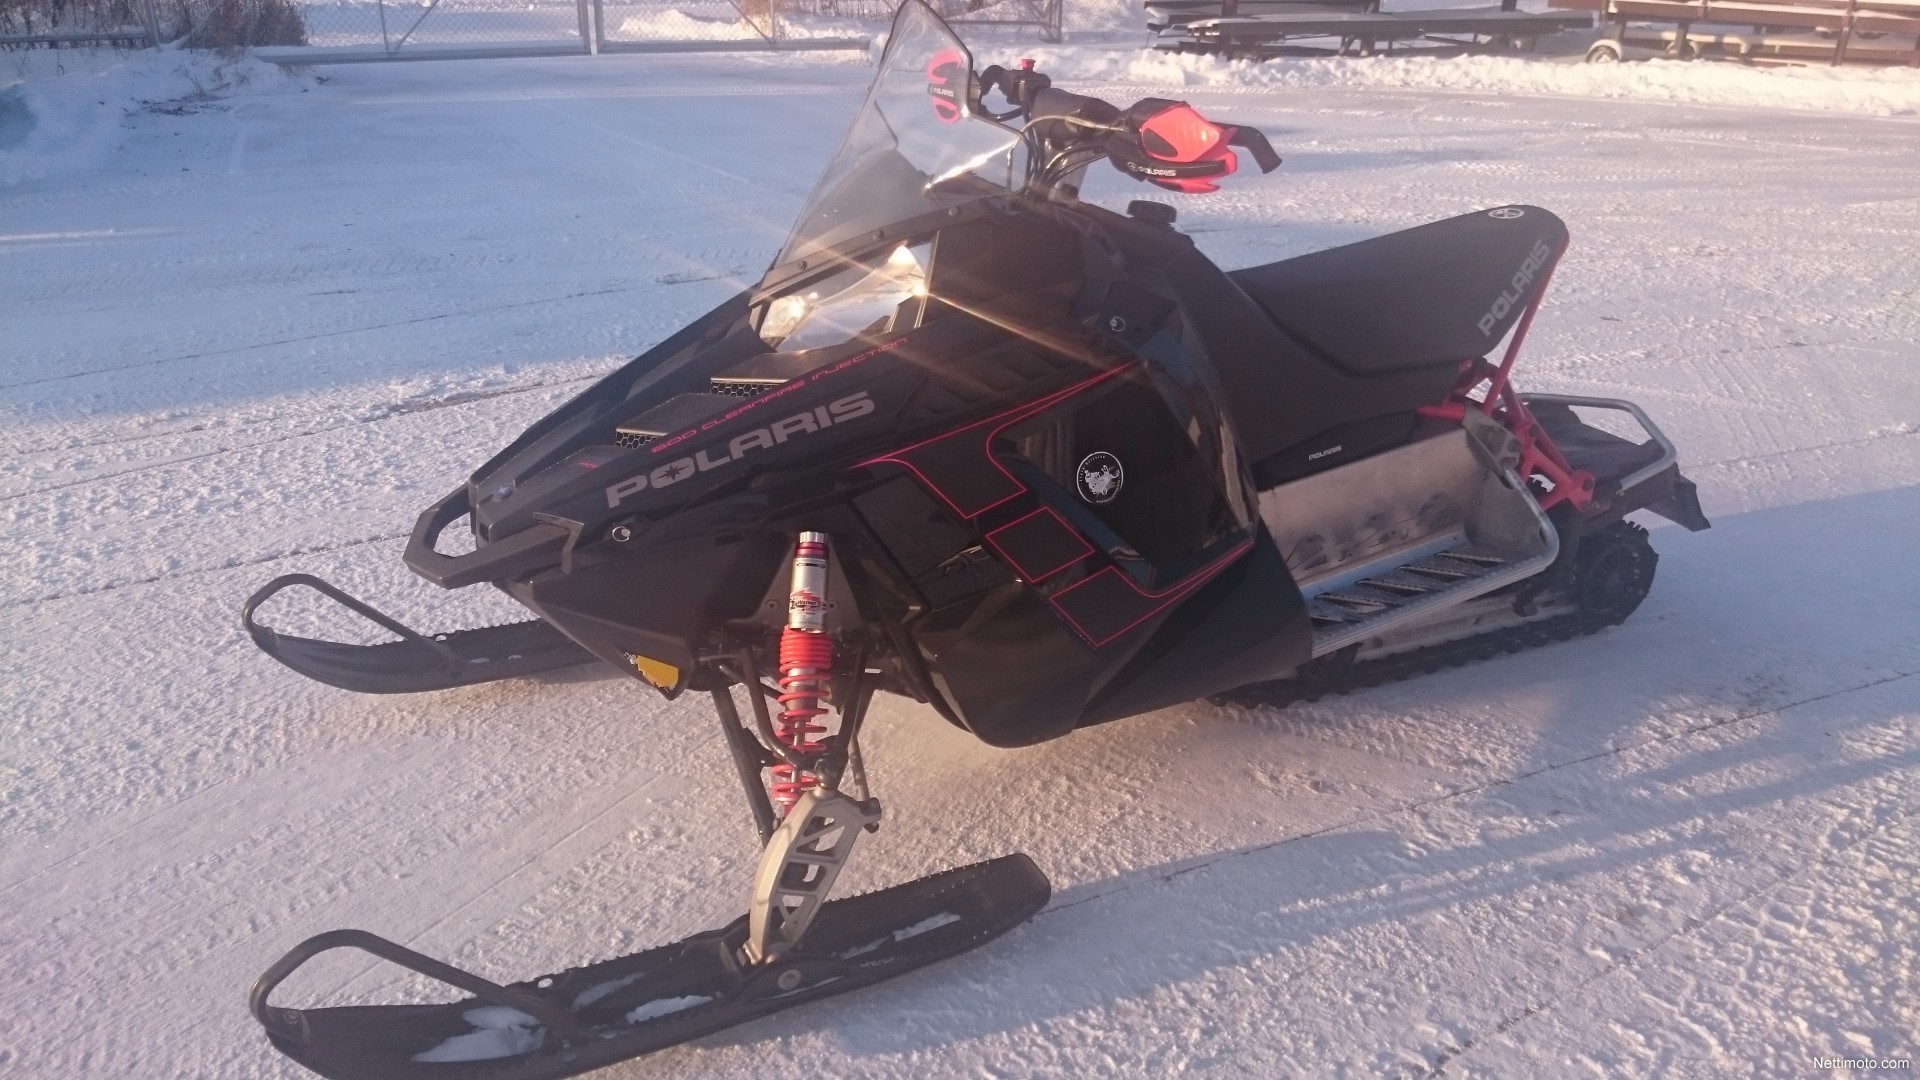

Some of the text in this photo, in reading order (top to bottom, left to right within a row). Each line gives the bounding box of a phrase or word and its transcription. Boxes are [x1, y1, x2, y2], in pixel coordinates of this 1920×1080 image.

[1138, 166, 1177, 177] POLARIS
[1477, 239, 1550, 337] POLARIS
[651, 336, 908, 454] 600 CLEANFIRE INJECTION
[605, 390, 875, 509] POLARIS
[1308, 445, 1342, 461] POLARIS
